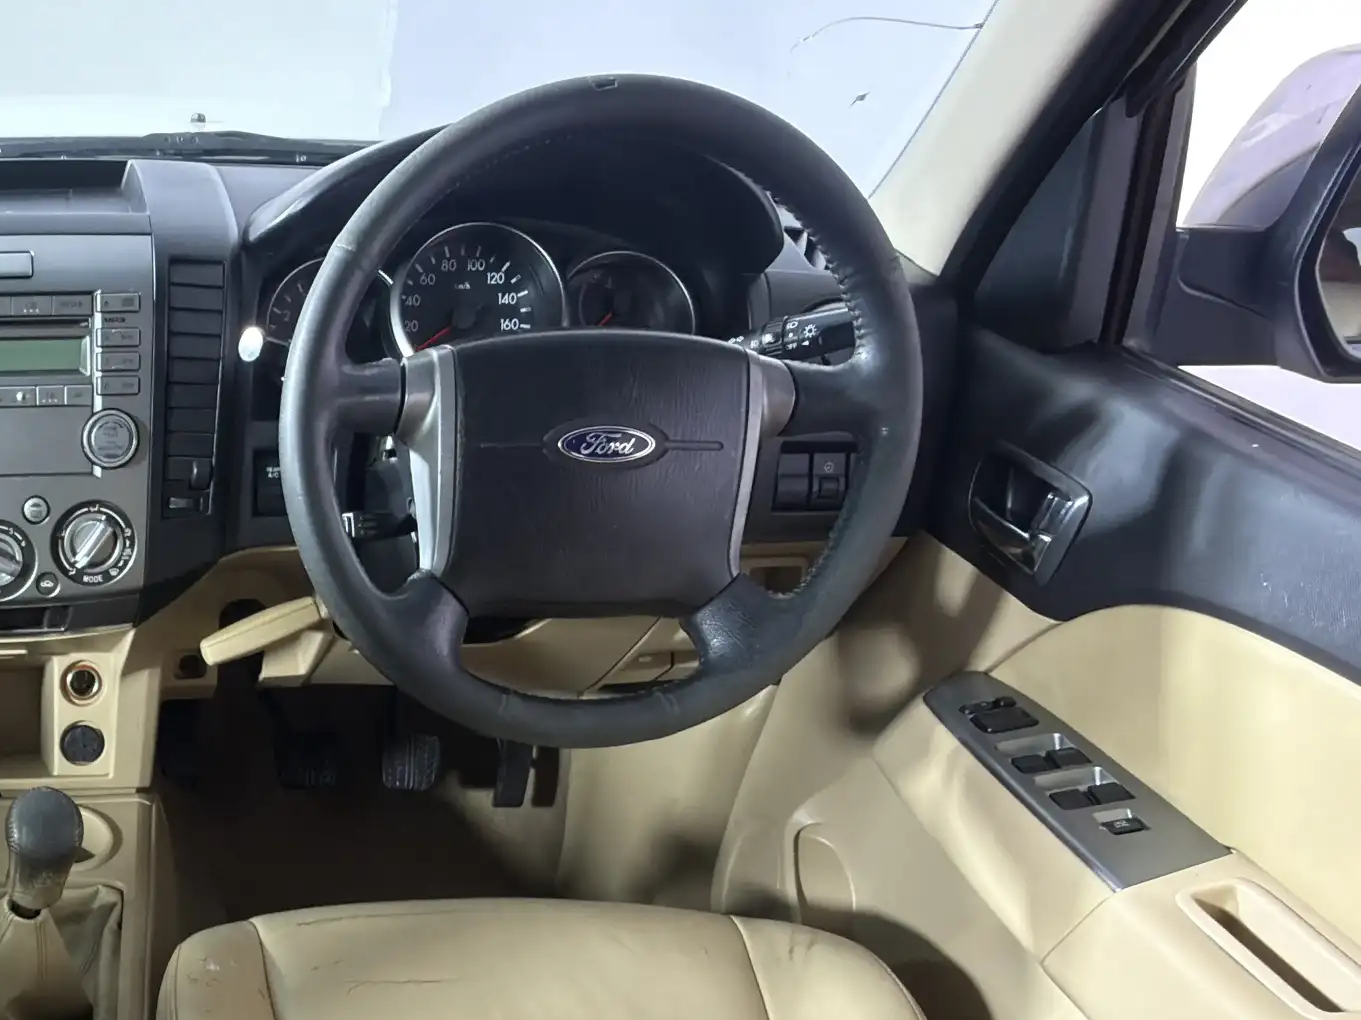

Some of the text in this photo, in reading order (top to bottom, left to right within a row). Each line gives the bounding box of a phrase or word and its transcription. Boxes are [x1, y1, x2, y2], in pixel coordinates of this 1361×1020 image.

[440, 258, 457, 272] 80
[467, 258, 486, 271] 100
[419, 273, 436, 286] 60
[486, 271, 505, 285] 120
[405, 294, 422, 307] 40
[497, 292, 517, 305] 140
[404, 319, 419, 332] 20
[500, 318, 519, 331] 160
[579, 432, 636, 455] Ford
[82, 574, 104, 583] MODE
